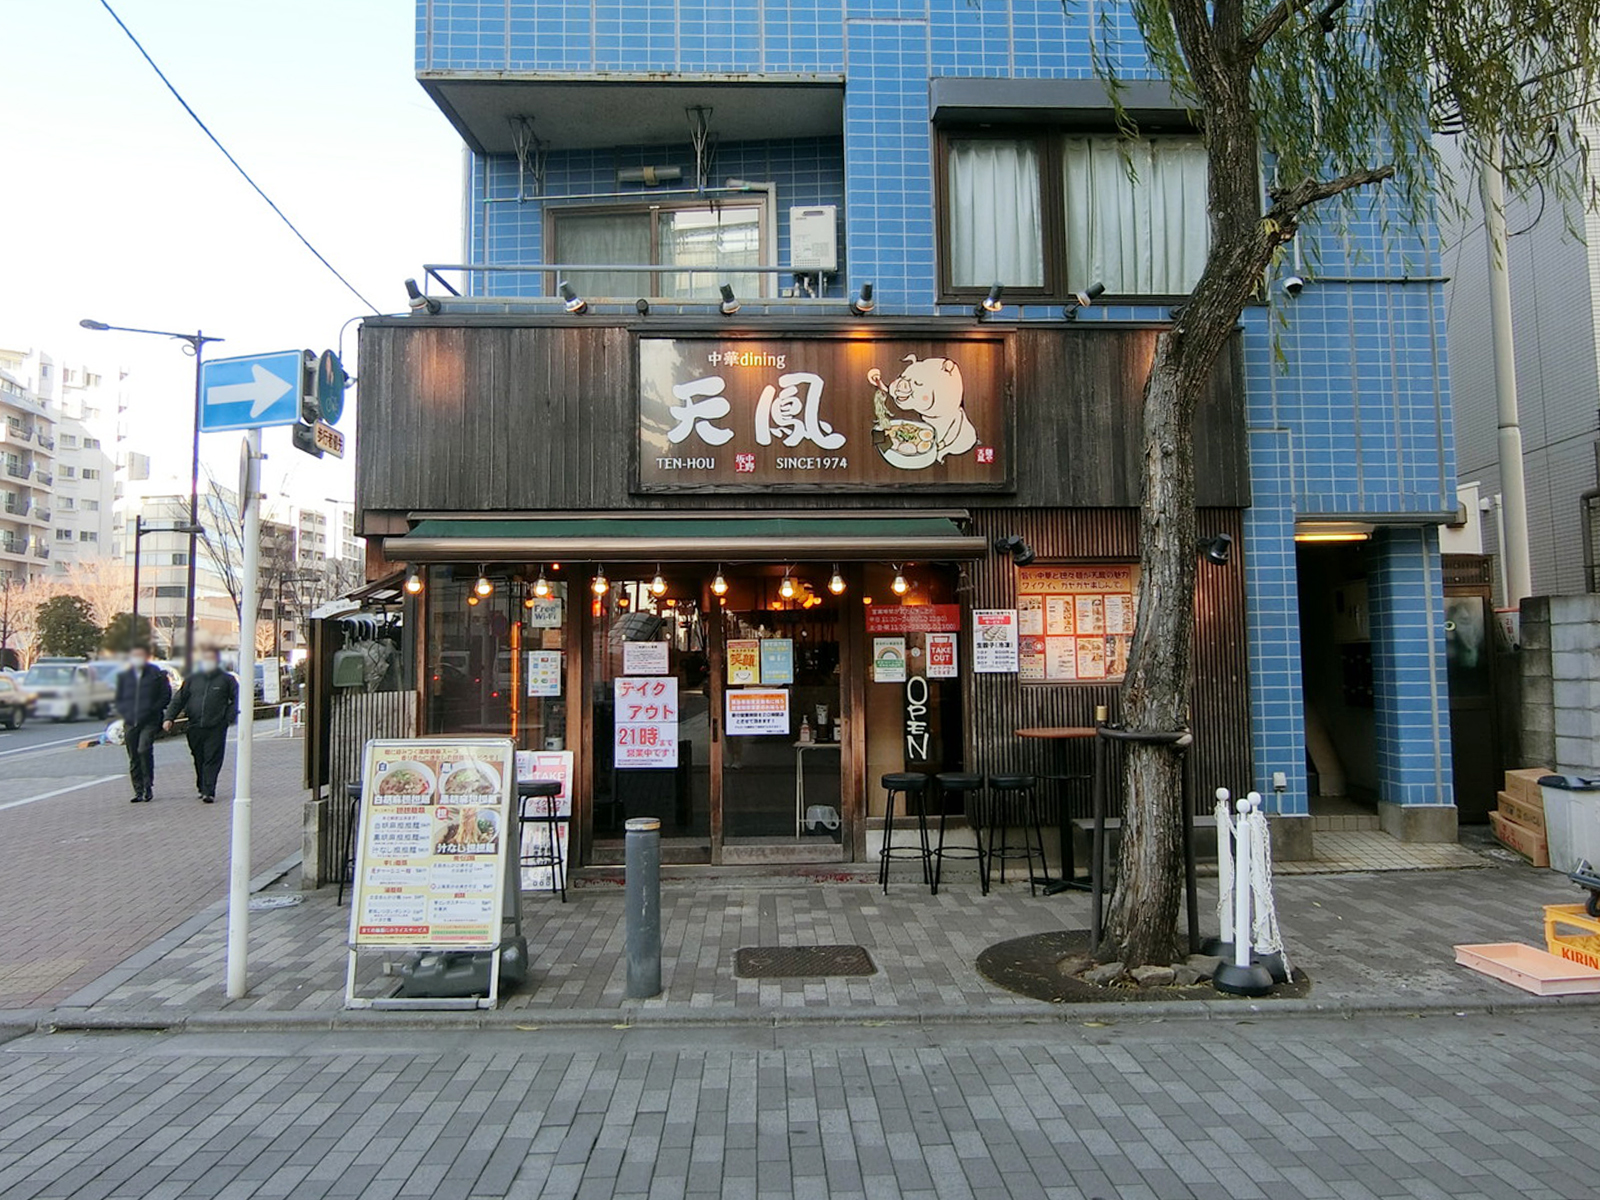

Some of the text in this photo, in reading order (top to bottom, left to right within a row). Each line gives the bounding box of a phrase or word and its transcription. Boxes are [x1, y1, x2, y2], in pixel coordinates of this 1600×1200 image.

[707, 350, 787, 370] 中華dining
[666, 371, 847, 450] 天鳳
[655, 456, 716, 471] TEN-HOU
[775, 456, 849, 470] SINCE1974
[534, 604, 556, 613] Free
[534, 612, 557, 620] Wi-Fi
[931, 647, 952, 655] TAKE
[620, 681, 666, 697] テイク
[628, 704, 674, 720] アウト
[906, 676, 930, 760] OPEN
[1561, 947, 1599, 970] KIRIN
